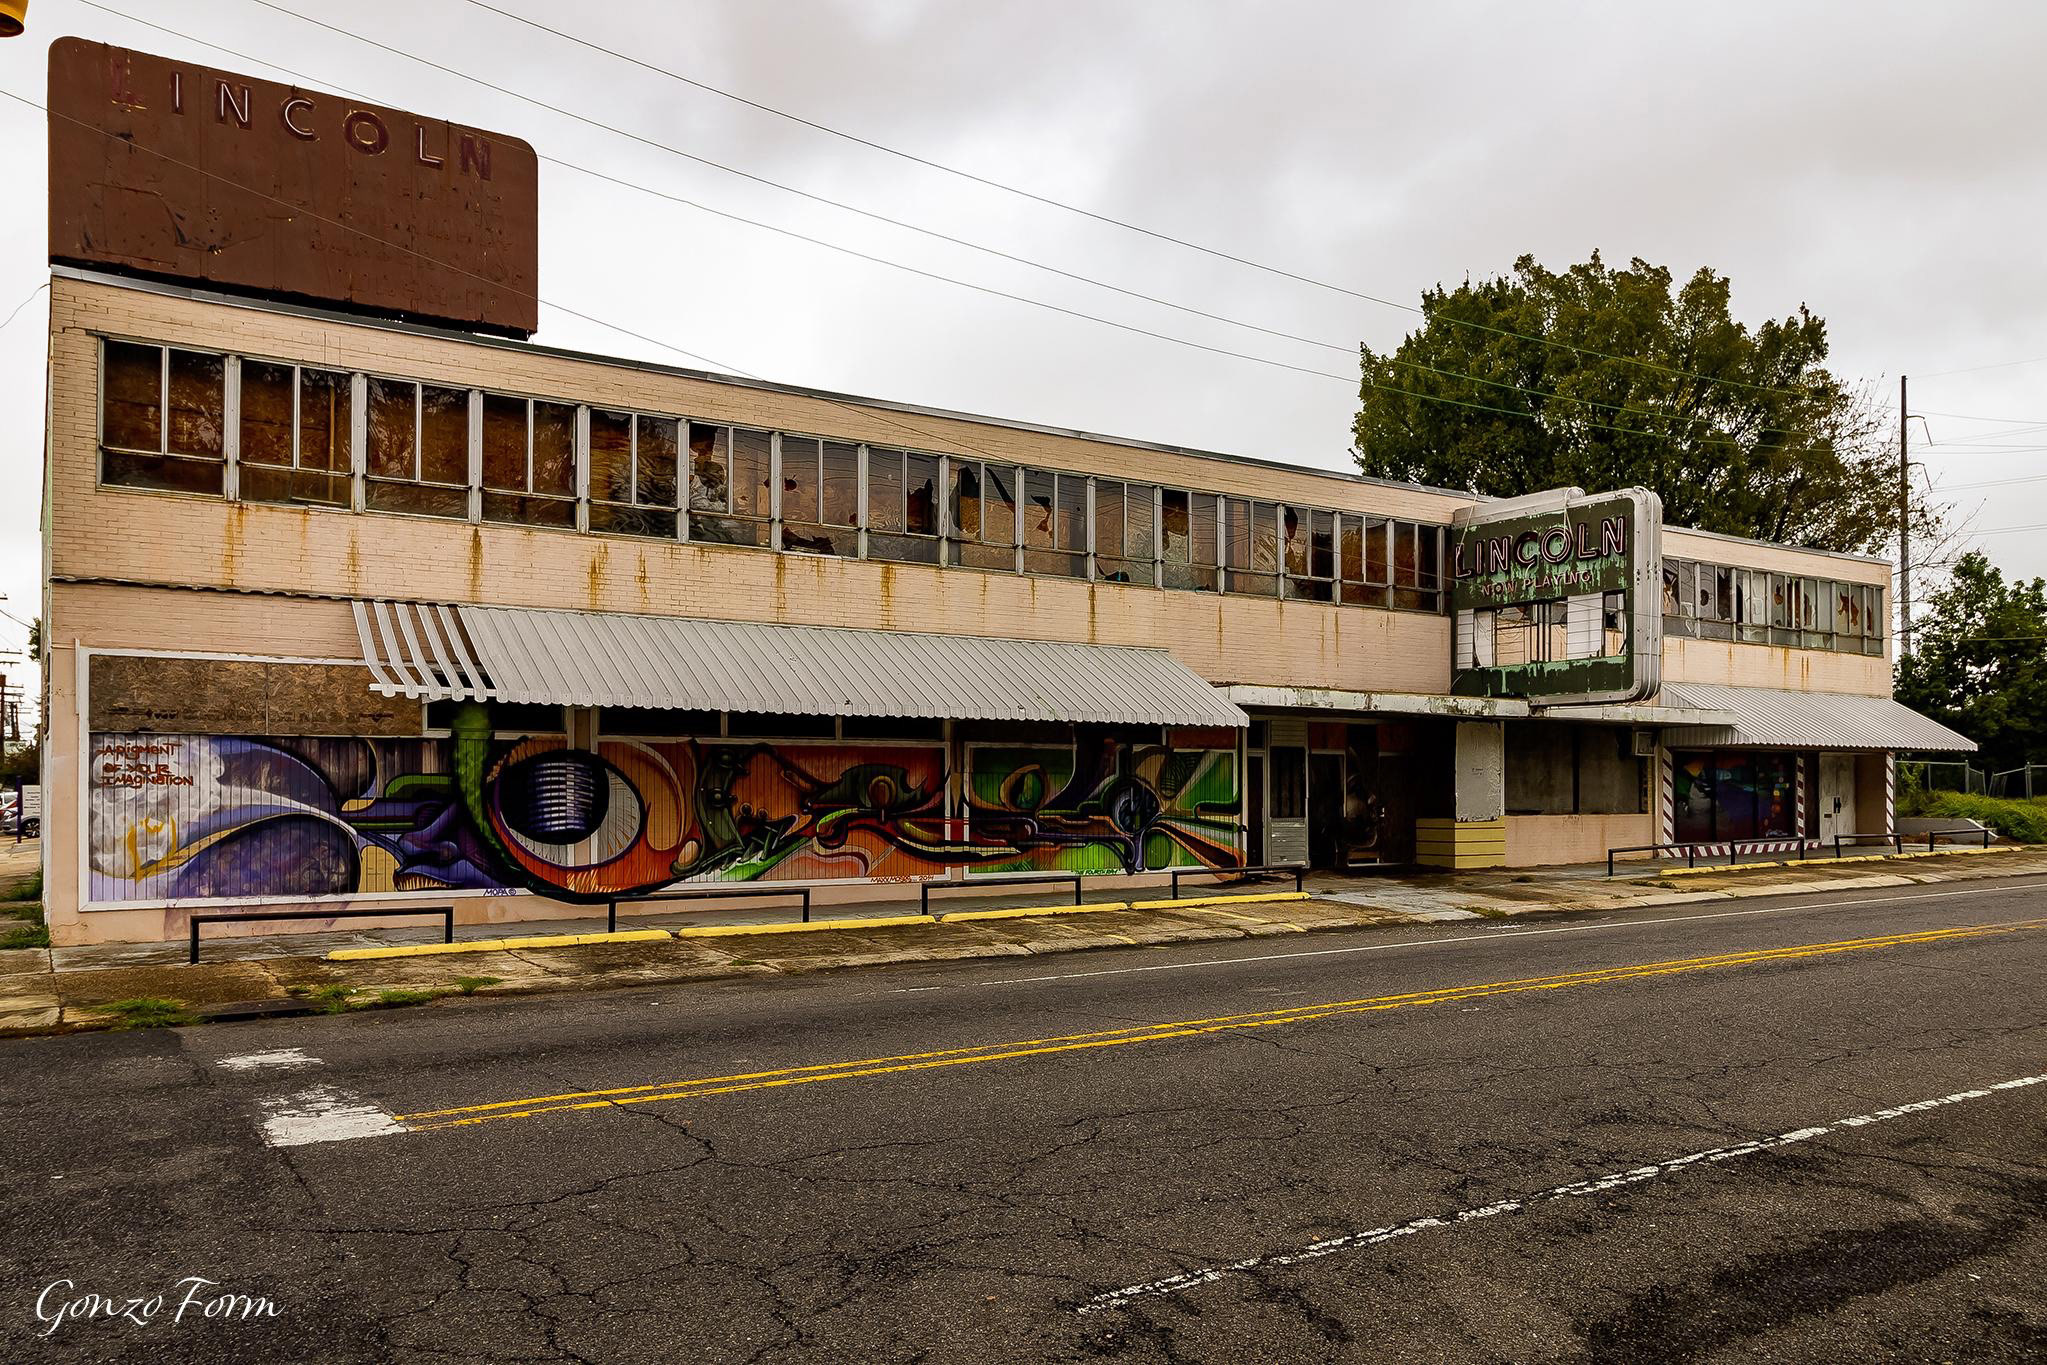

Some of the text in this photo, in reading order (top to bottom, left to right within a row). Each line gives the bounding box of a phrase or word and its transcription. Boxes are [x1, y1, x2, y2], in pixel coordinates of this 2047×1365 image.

[110, 57, 491, 181] LINCOLN
[1455, 516, 1626, 579] LINCOLN
[1482, 570, 1592, 596] NOW PLAYING
[103, 763, 172, 775] OF YOUR
